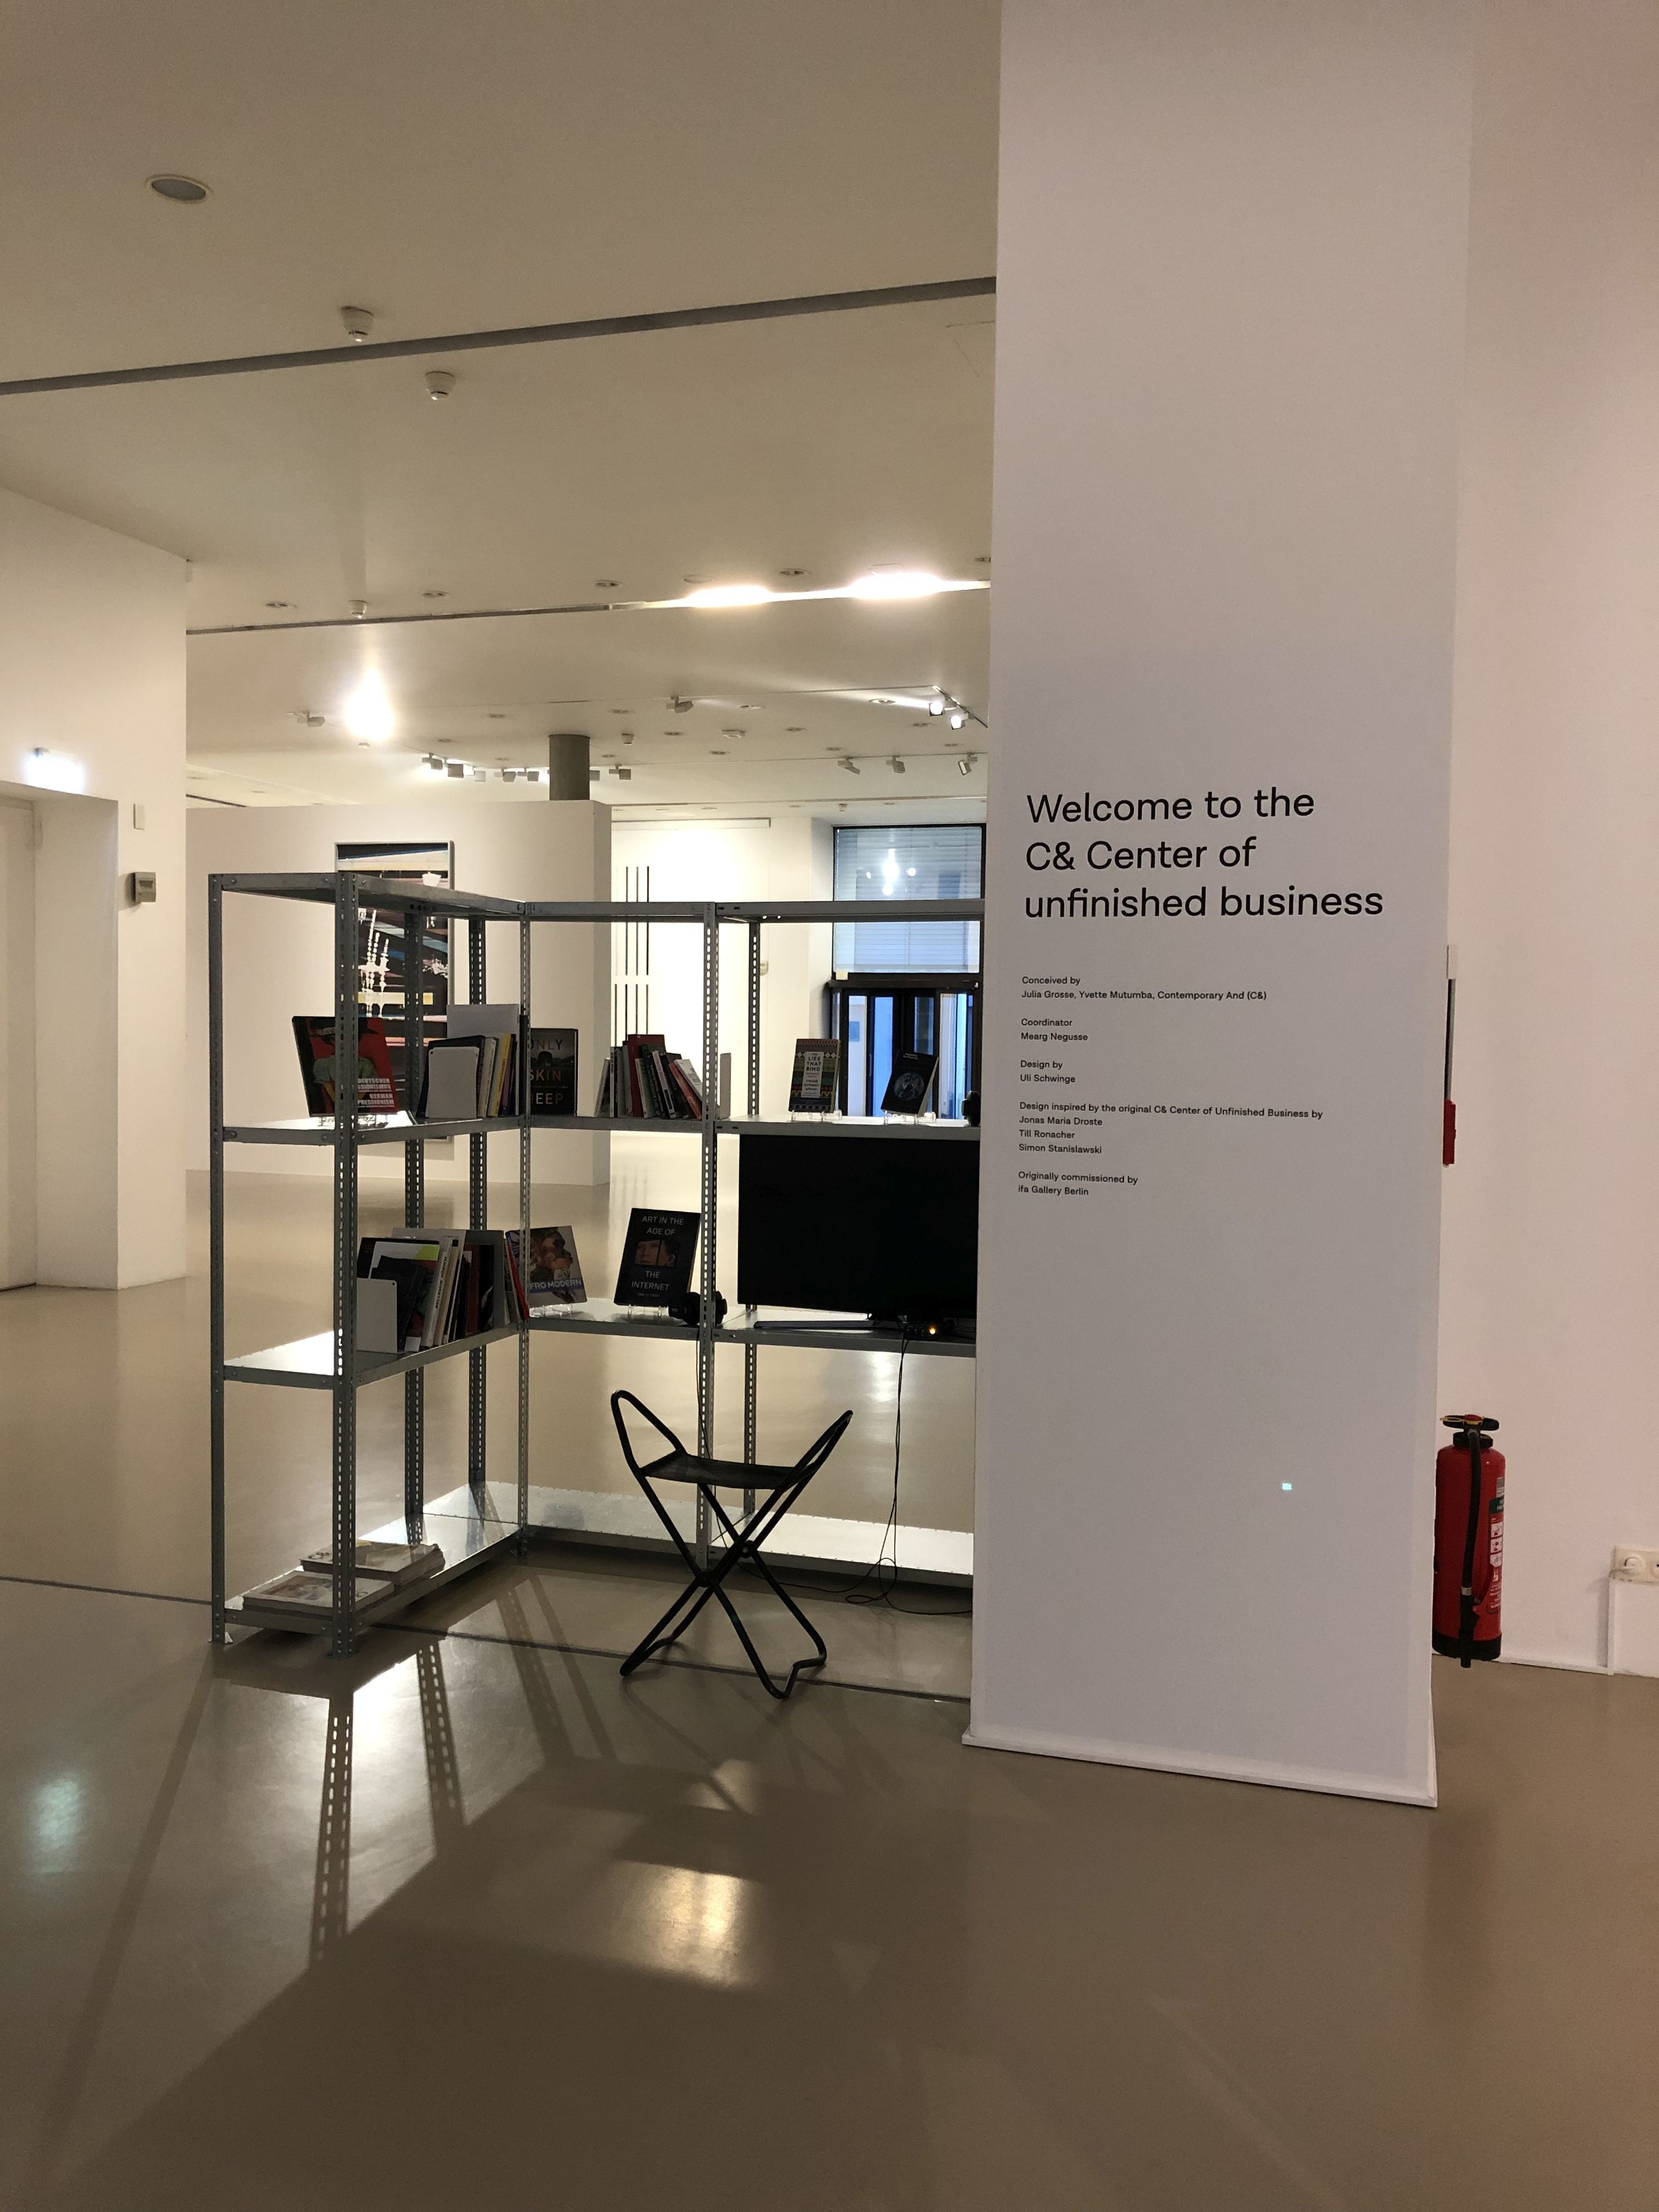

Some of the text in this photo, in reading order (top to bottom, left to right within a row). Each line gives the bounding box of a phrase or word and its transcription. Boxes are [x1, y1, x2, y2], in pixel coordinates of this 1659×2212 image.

[1026, 786, 1314, 823] Welcome to the
[1026, 836, 1257, 871] C& Center of
[1025, 884, 1383, 918] unfinished business
[1022, 975, 1081, 986] Conceived by
[1021, 990, 1267, 1001] Julia Grosse, Yvette Mutumba, Contemporary And (C&)
[1021, 1018, 1073, 1026] Coordinator
[1020, 1032, 1088, 1042] Mearg Negusse
[1020, 1059, 1063, 1071] Design by
[1020, 1074, 1076, 1085] Uli Schwinge
[1019, 1101, 1323, 1120] Design inspired by the original C& Center of Unfinished Business by
[1019, 1115, 1103, 1126] Jonas Maria Droste
[1018, 1129, 1076, 1139] Till Ronacher
[1018, 1143, 1102, 1154] Simon Stanislawski
[1018, 1171, 1138, 1186] Originally commissioned by
[1018, 1184, 1089, 1197] ifa Gallery Berlin
[669, 1217, 684, 1226] THE
[646, 1227, 663, 1235] AGE
[645, 1270, 661, 1278] THE
[548, 1279, 582, 1288] MODERN
[630, 1281, 670, 1291] INTERNET
